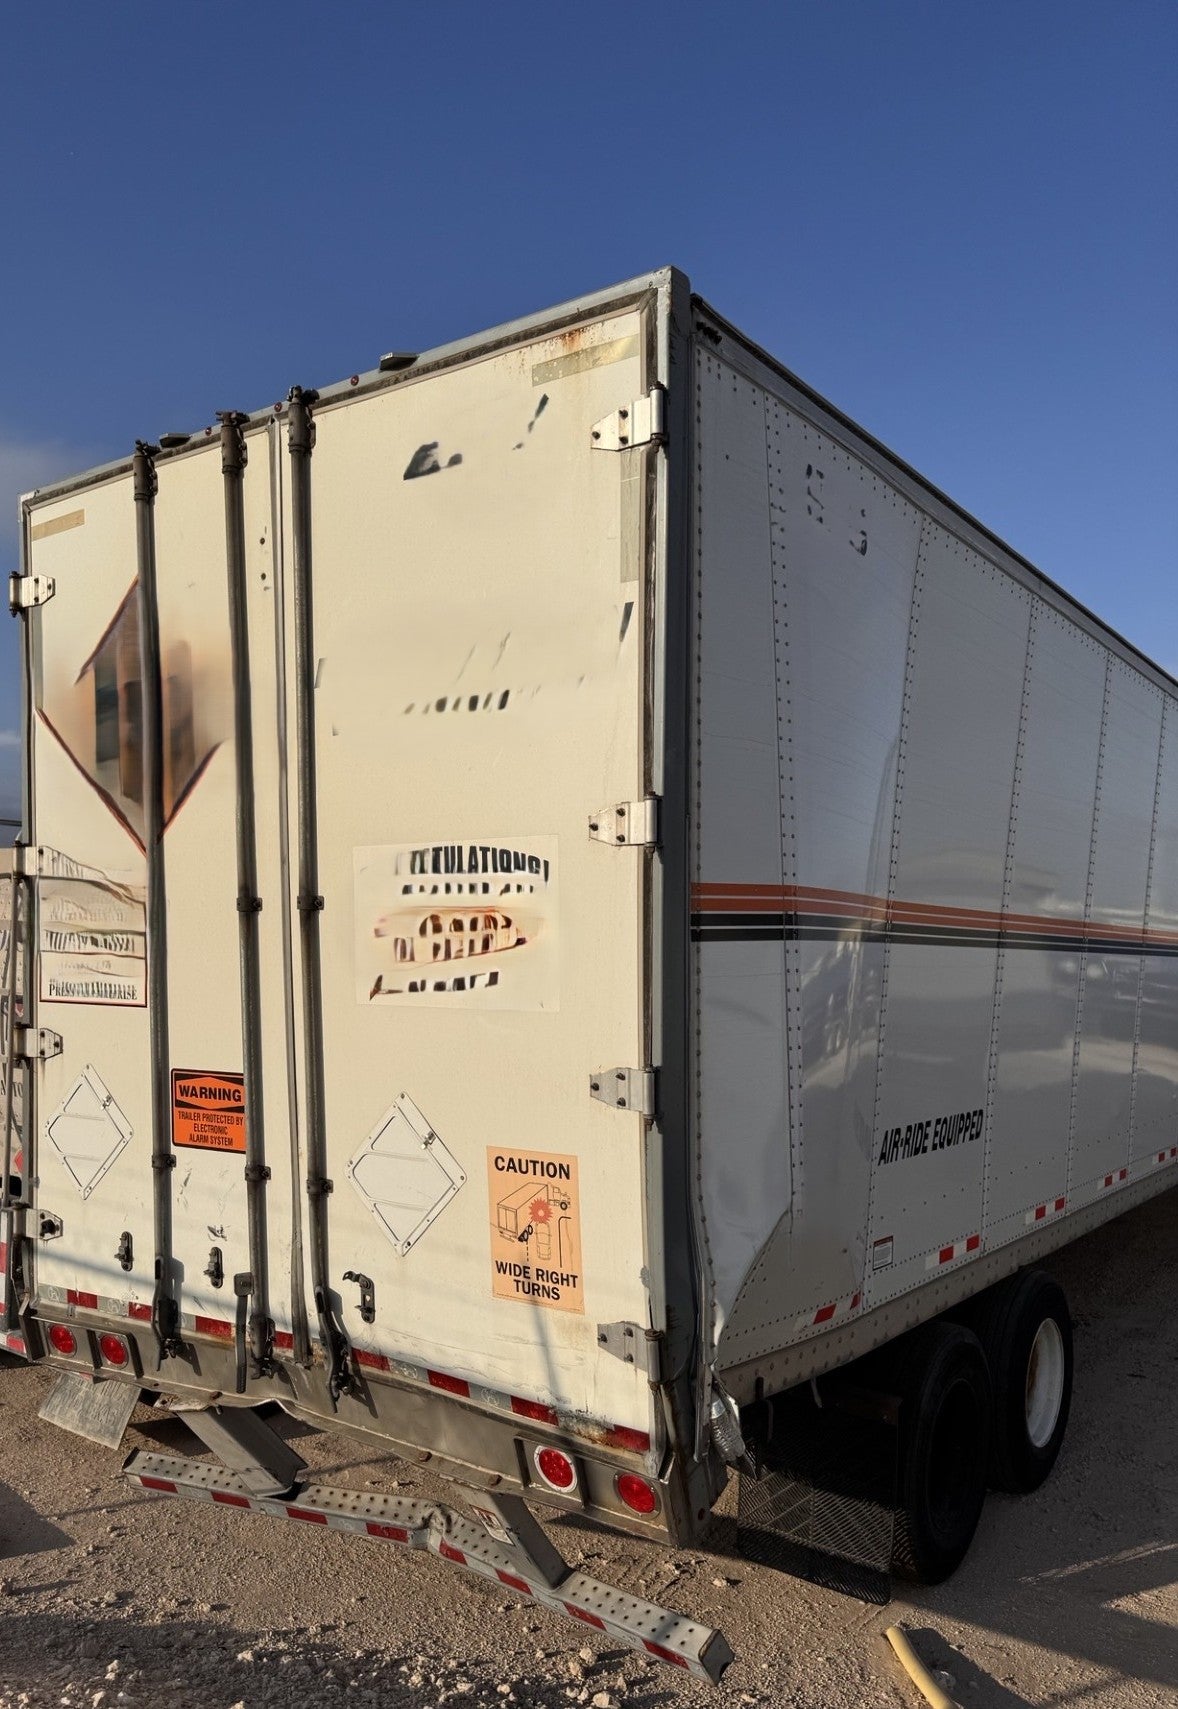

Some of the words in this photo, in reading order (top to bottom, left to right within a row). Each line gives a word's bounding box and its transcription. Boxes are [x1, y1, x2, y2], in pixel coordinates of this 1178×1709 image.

[179, 1085, 242, 1102] WARNING
[178, 1111, 201, 1121] TRAILER
[202, 1114, 235, 1125] PROTECTED
[236, 1117, 244, 1126] BY
[193, 1123, 228, 1135] ELECTRONIC
[878, 1120, 932, 1167] AIR-RIDE
[932, 1109, 984, 1152] EQUIPPED
[189, 1133, 209, 1143] ALARM
[210, 1136, 234, 1147] SYSTEM
[494, 1155, 571, 1181] CAUTION
[495, 1260, 531, 1280] WIDE
[536, 1268, 579, 1289] RIGHT
[513, 1279, 561, 1301] TURNS
